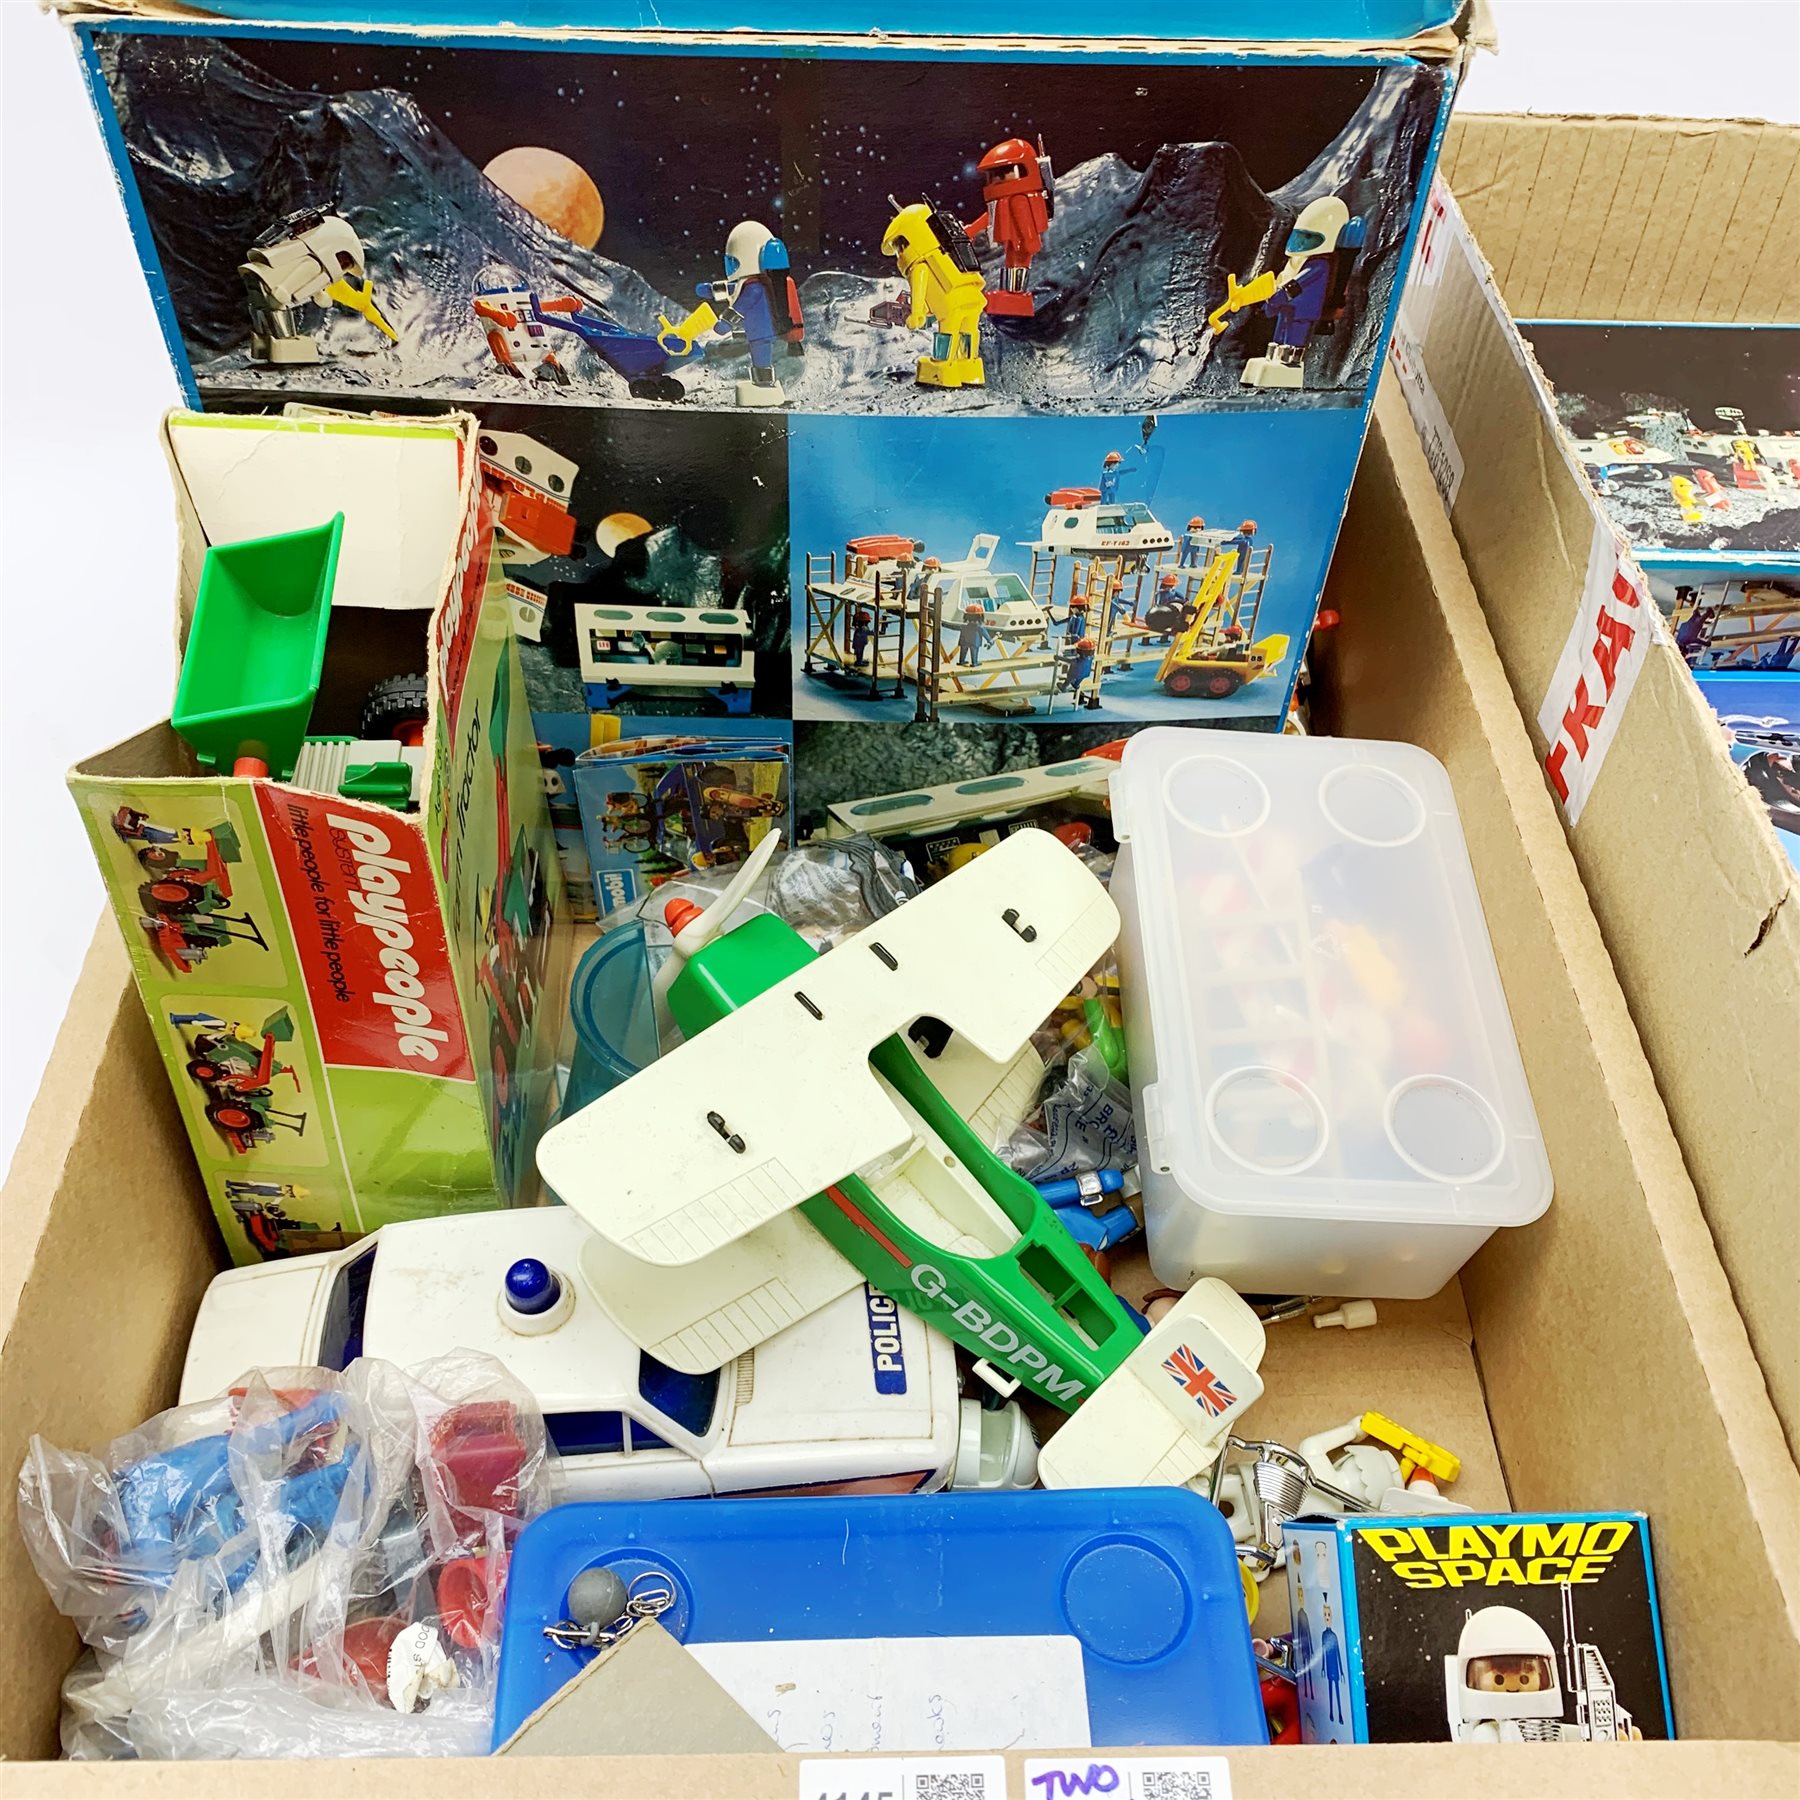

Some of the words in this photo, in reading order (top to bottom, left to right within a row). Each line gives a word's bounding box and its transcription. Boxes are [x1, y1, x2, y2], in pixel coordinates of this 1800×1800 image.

[456, 698, 481, 840] Tractor
[287, 803, 314, 838] little
[298, 836, 331, 895] people
[313, 891, 335, 920] for
[319, 916, 345, 953] little
[325, 813, 449, 1062] playpeople
[321, 949, 351, 1003] people
[910, 1263, 1086, 1402] G-BDPM
[1357, 1521, 1634, 1562] PLAYMO
[1391, 1556, 1614, 1589] SPACE
[1031, 1762, 1120, 1800] TWO
